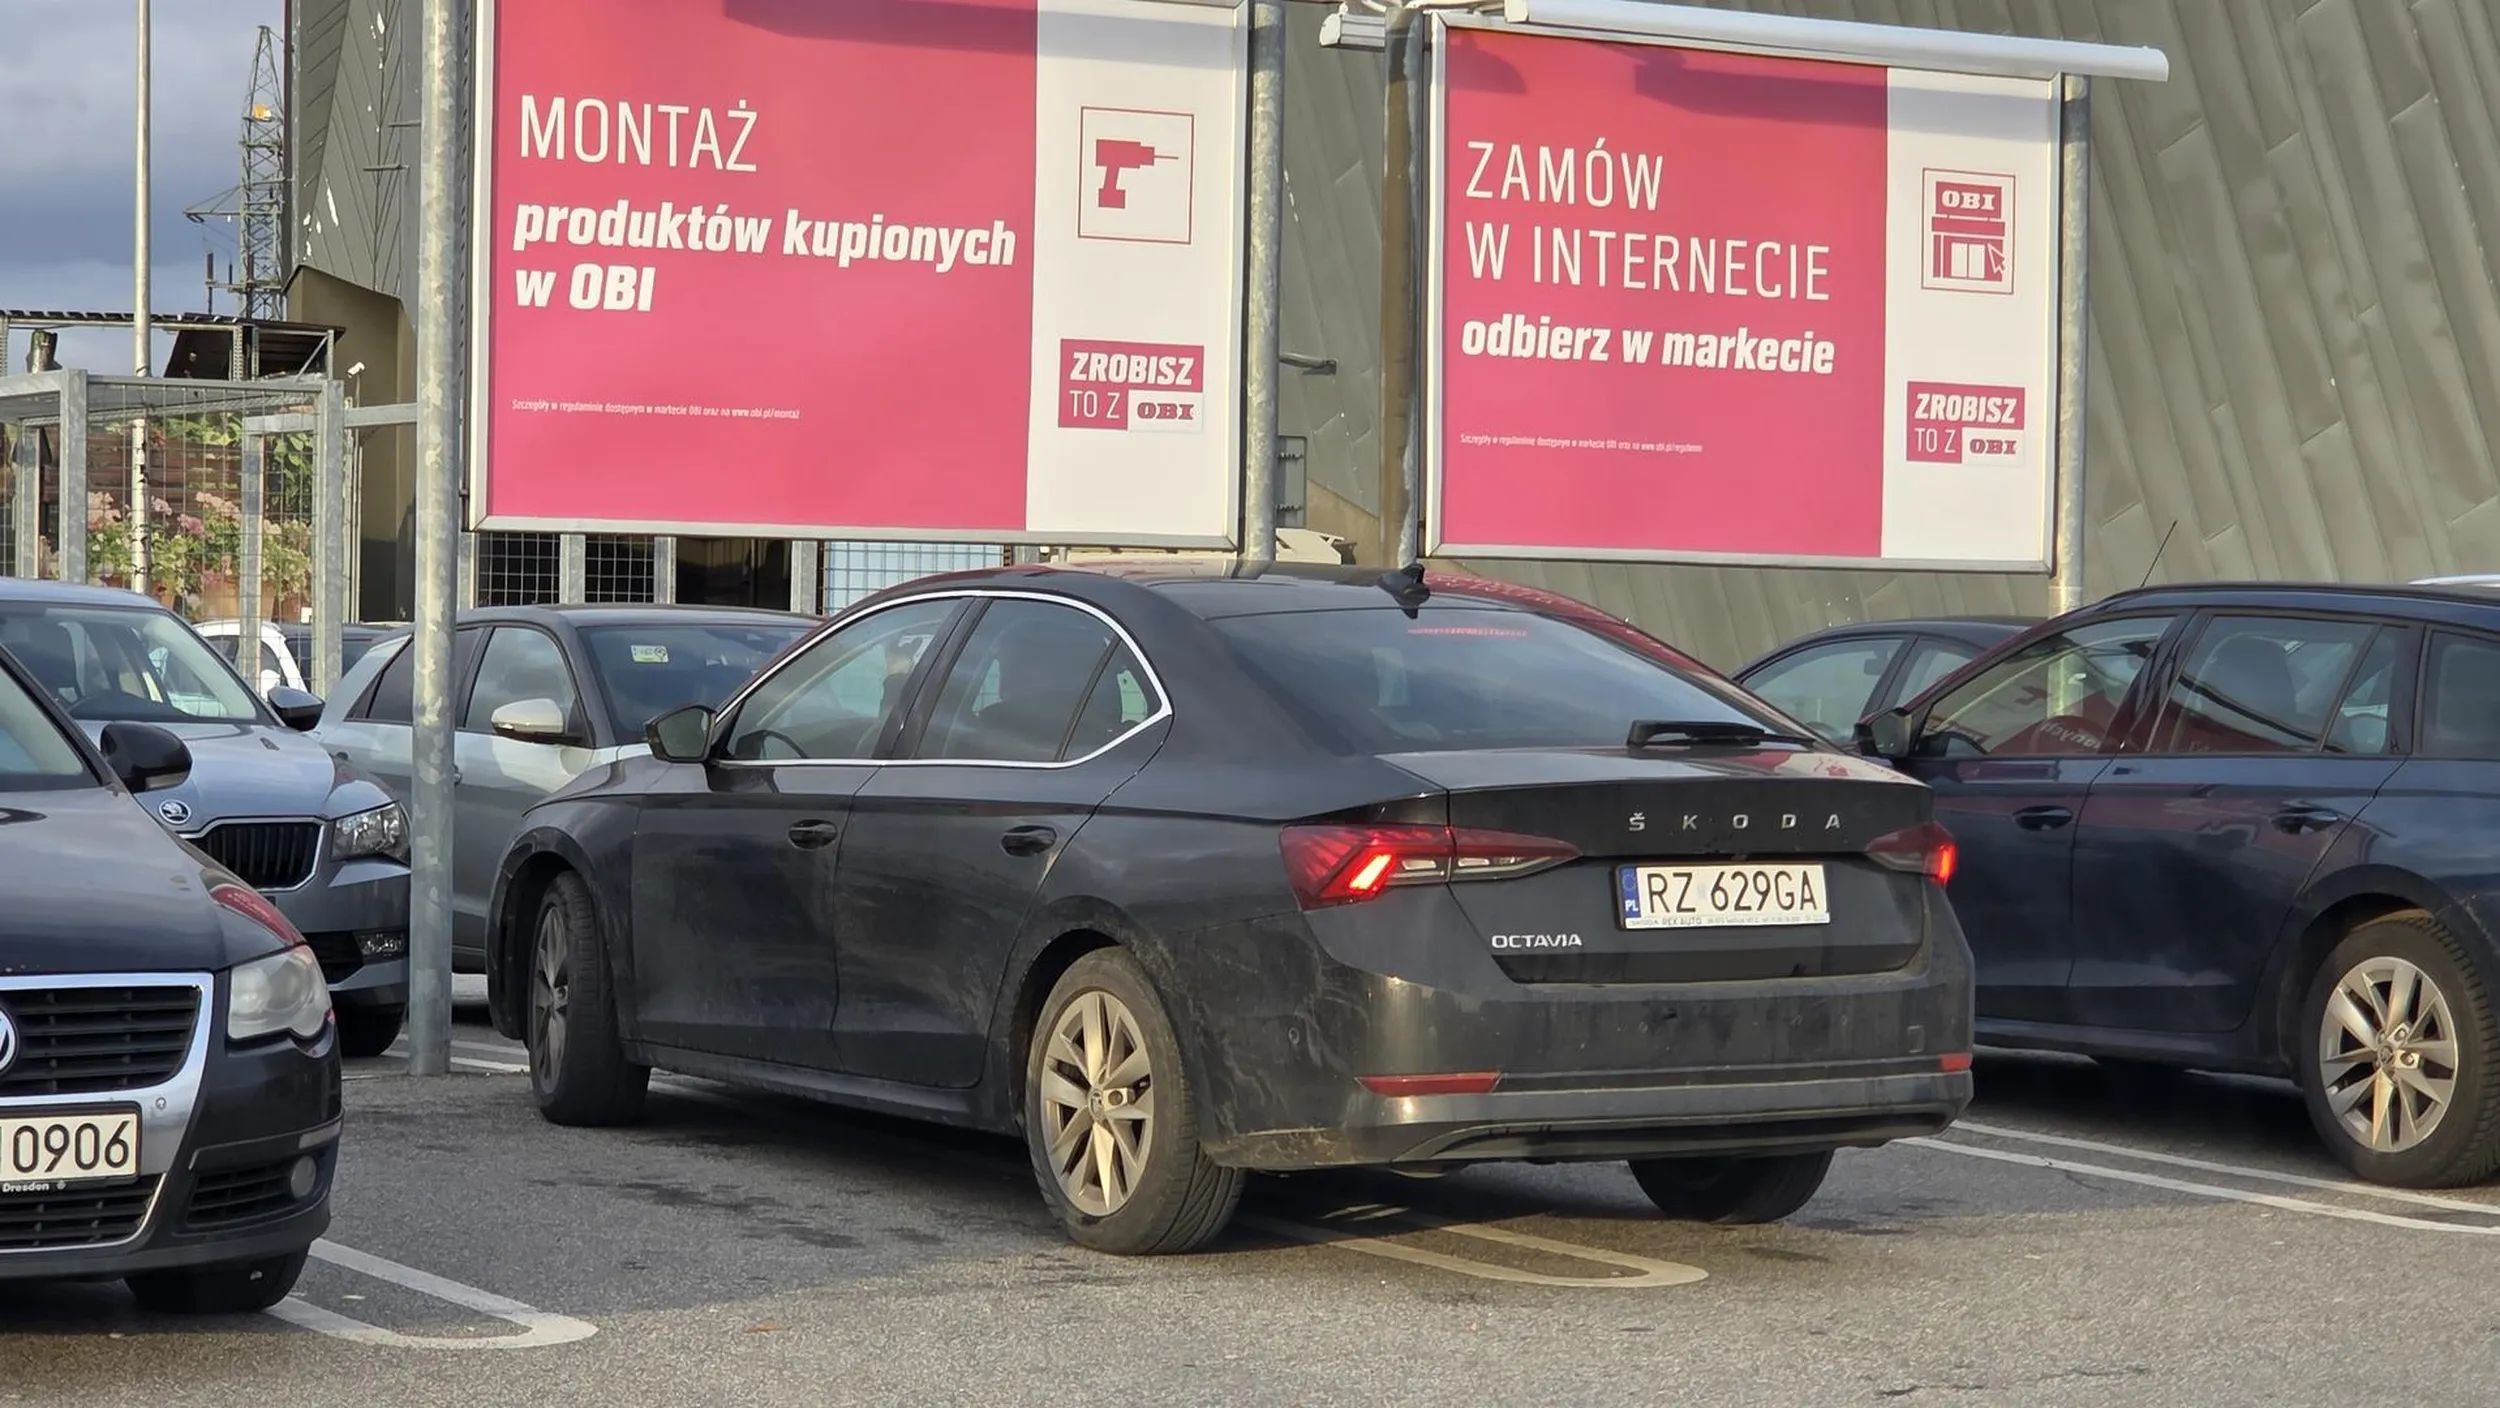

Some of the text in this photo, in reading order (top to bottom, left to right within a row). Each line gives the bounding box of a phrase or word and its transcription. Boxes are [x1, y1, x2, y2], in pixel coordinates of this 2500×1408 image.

[520, 94, 757, 172] MONTAŻ
[1466, 138, 1663, 211] ZAMÓW
[1941, 189, 1995, 211] OBI
[513, 200, 1016, 274] produktów kupionych
[1466, 222, 1830, 301] W INTERNECIE
[515, 263, 655, 312] w OBI
[1462, 314, 1835, 375] odbierz w markecie
[1069, 350, 1194, 386] ZROBISZ
[1069, 389, 1194, 420] TO Z OBI
[1914, 393, 2017, 424] ZROBISZ
[1914, 427, 2018, 456] TO Z OBI
[1628, 812, 1841, 831] ŠKODA
[1625, 899, 1639, 912] PL
[1647, 870, 1817, 913] RZ 629GA
[1491, 933, 1583, 949] OCTAVIA
[0, 1119, 129, 1174] 0906
[2, 1182, 50, 1193] Dresden
